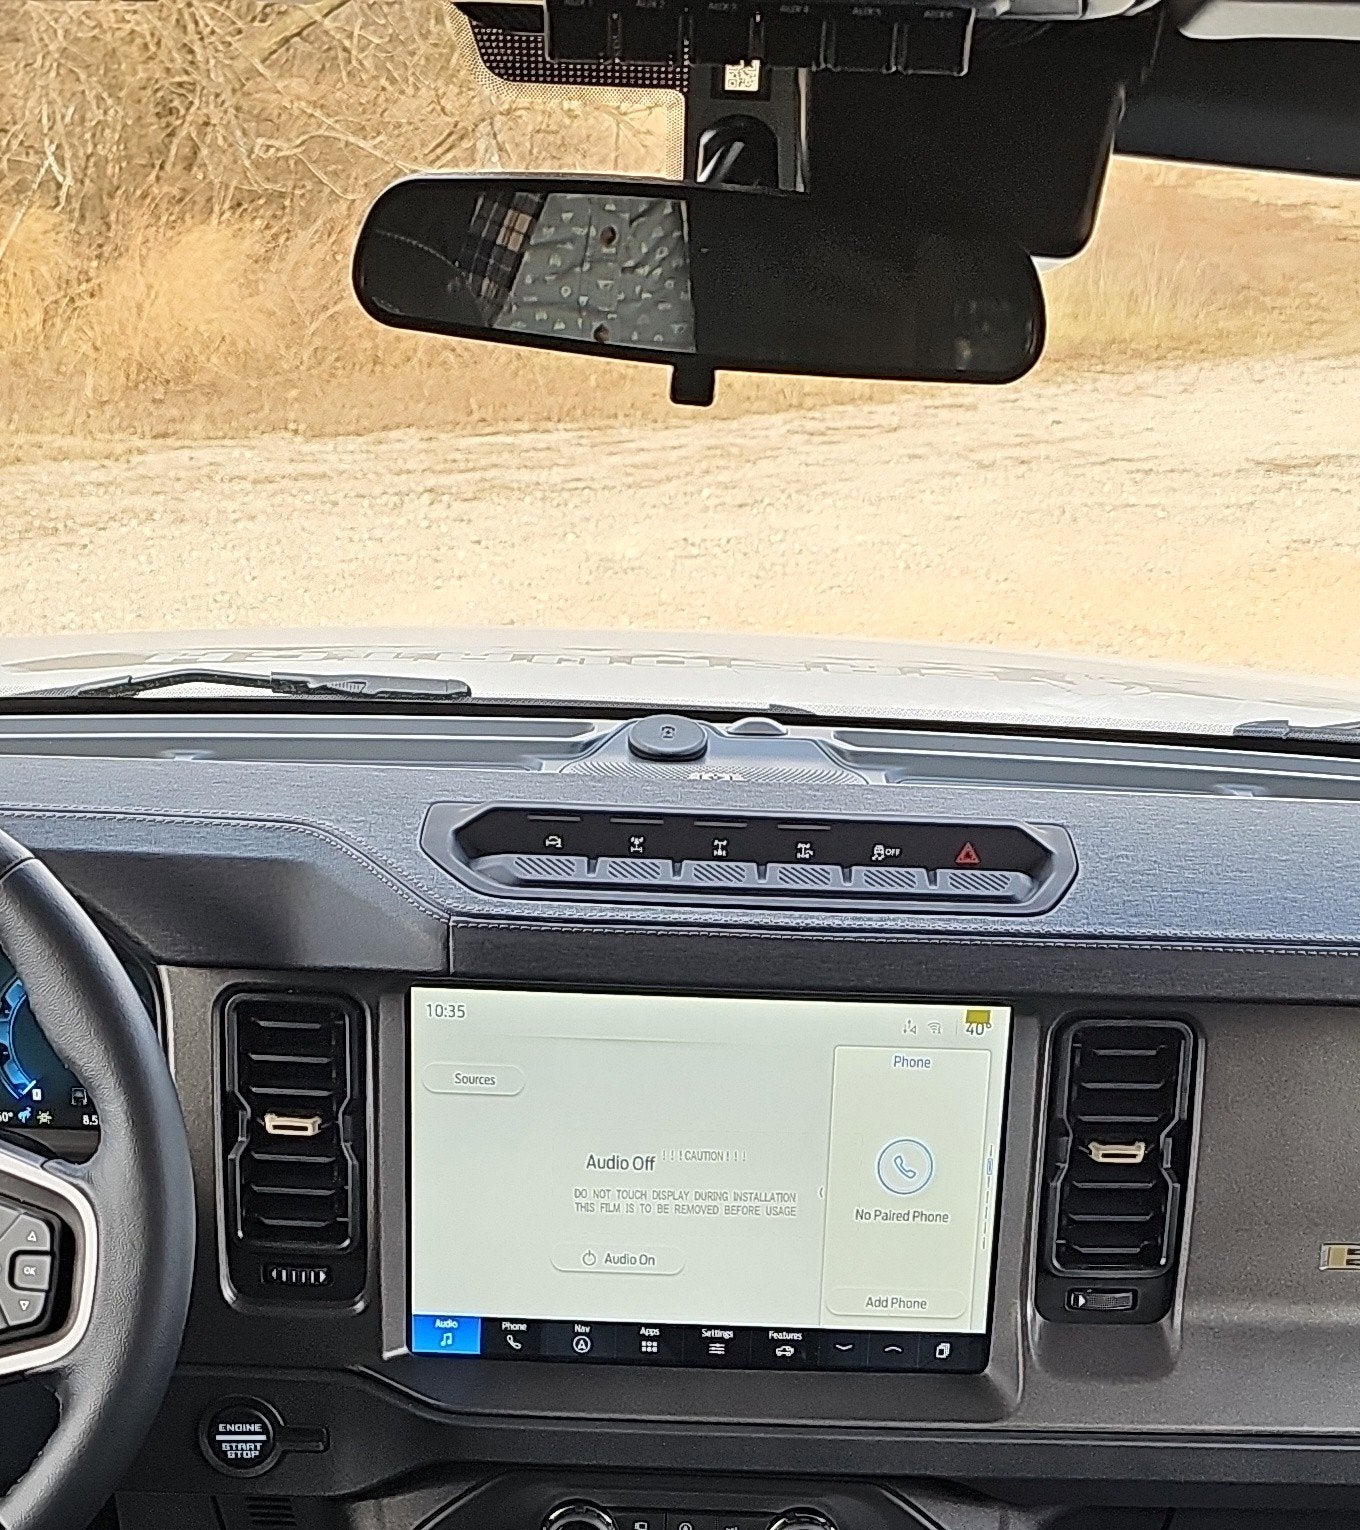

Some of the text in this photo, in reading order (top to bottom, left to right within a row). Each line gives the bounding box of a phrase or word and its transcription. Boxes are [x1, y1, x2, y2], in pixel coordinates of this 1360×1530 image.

[885, 848, 900, 857] OFF
[426, 1003, 466, 1019] 10:35
[893, 1055, 931, 1069] Phone
[454, 1072, 496, 1086] Sources
[82, 1114, 99, 1126] 8.5
[586, 1153, 656, 1172] Audio Off
[574, 1188, 797, 1203] DO NOT TOUCH DISPLAY DURING INSTALLATION
[575, 1202, 797, 1217] THIS FILM IS TO BE REMOVED BEFORE USAGE
[855, 1208, 950, 1223] No Paired Phone
[604, 1252, 656, 1266] Audio On
[23, 1266, 37, 1277] OK
[865, 1296, 928, 1310] Add Phone
[435, 1318, 458, 1329] Audio
[501, 1321, 528, 1332] Phone
[574, 1323, 591, 1334] Nav
[640, 1326, 660, 1338] Apps
[701, 1328, 734, 1340] Settings
[768, 1330, 803, 1341] Features
[218, 1423, 263, 1432] ENGINE
[221, 1442, 263, 1451] START
[227, 1450, 260, 1459] STOP
